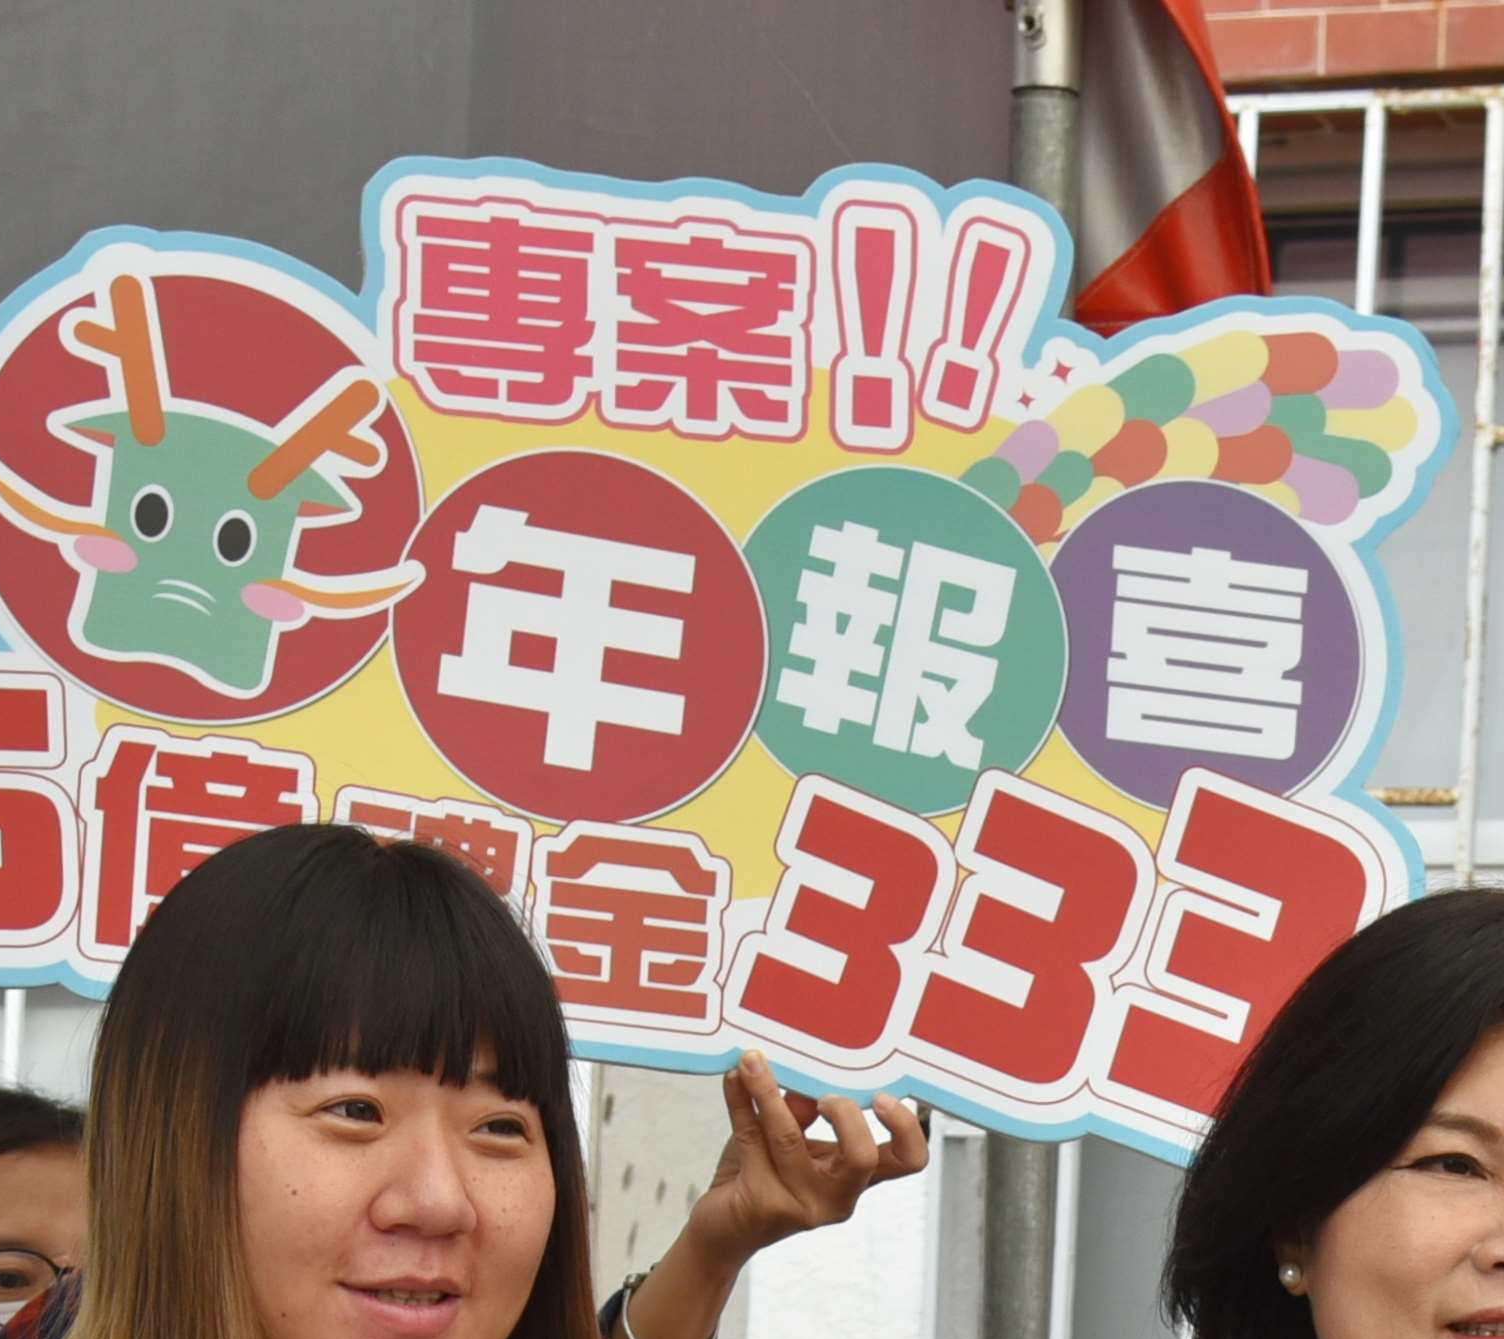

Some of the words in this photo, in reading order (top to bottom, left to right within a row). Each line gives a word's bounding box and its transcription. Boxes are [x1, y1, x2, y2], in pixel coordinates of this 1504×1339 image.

[408, 205, 1024, 447] 專案!!
[434, 502, 1312, 775] 年報喜
